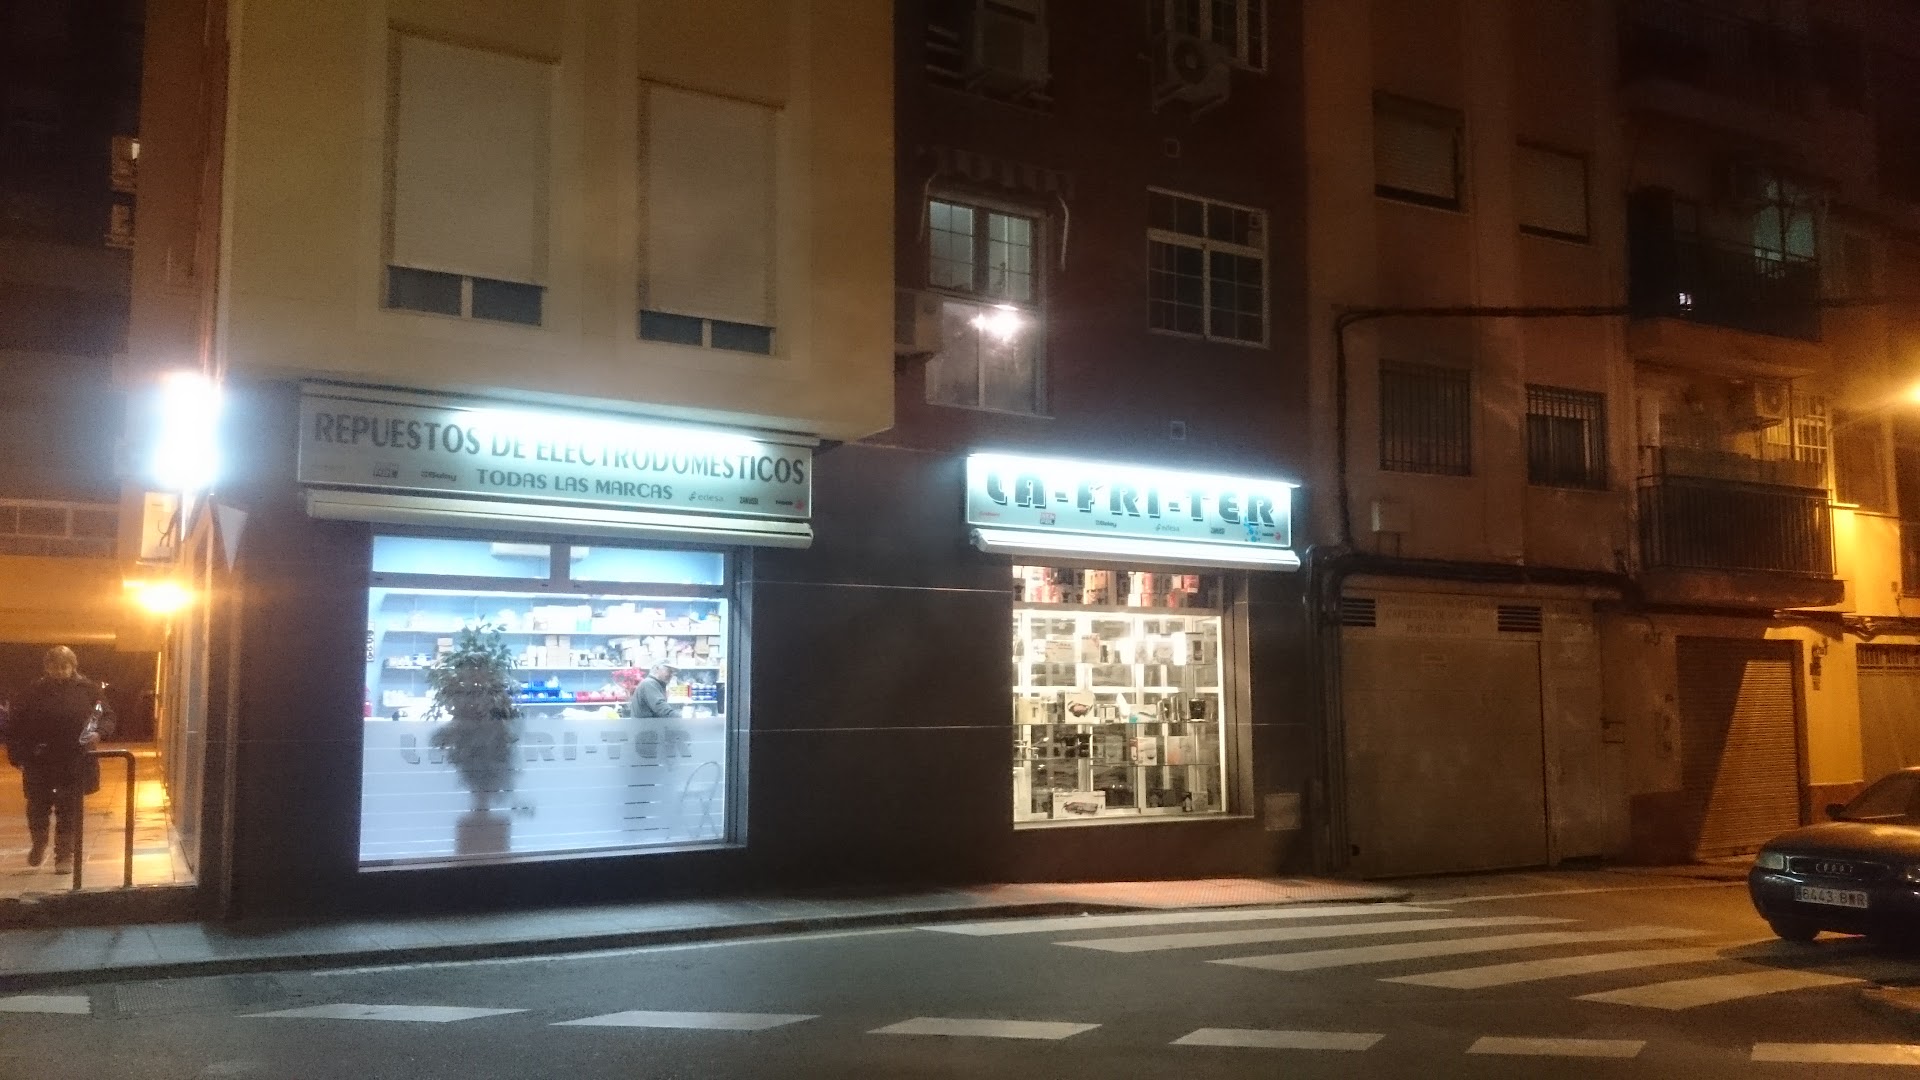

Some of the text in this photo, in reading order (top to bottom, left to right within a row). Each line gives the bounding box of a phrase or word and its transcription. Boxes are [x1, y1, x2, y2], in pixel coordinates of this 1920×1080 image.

[314, 413, 481, 455] REPUESTOS
[490, 429, 526, 460] DE
[476, 468, 673, 500] TODAS LAS MARCAS
[986, 468, 1275, 527] LA-FRI-TER
